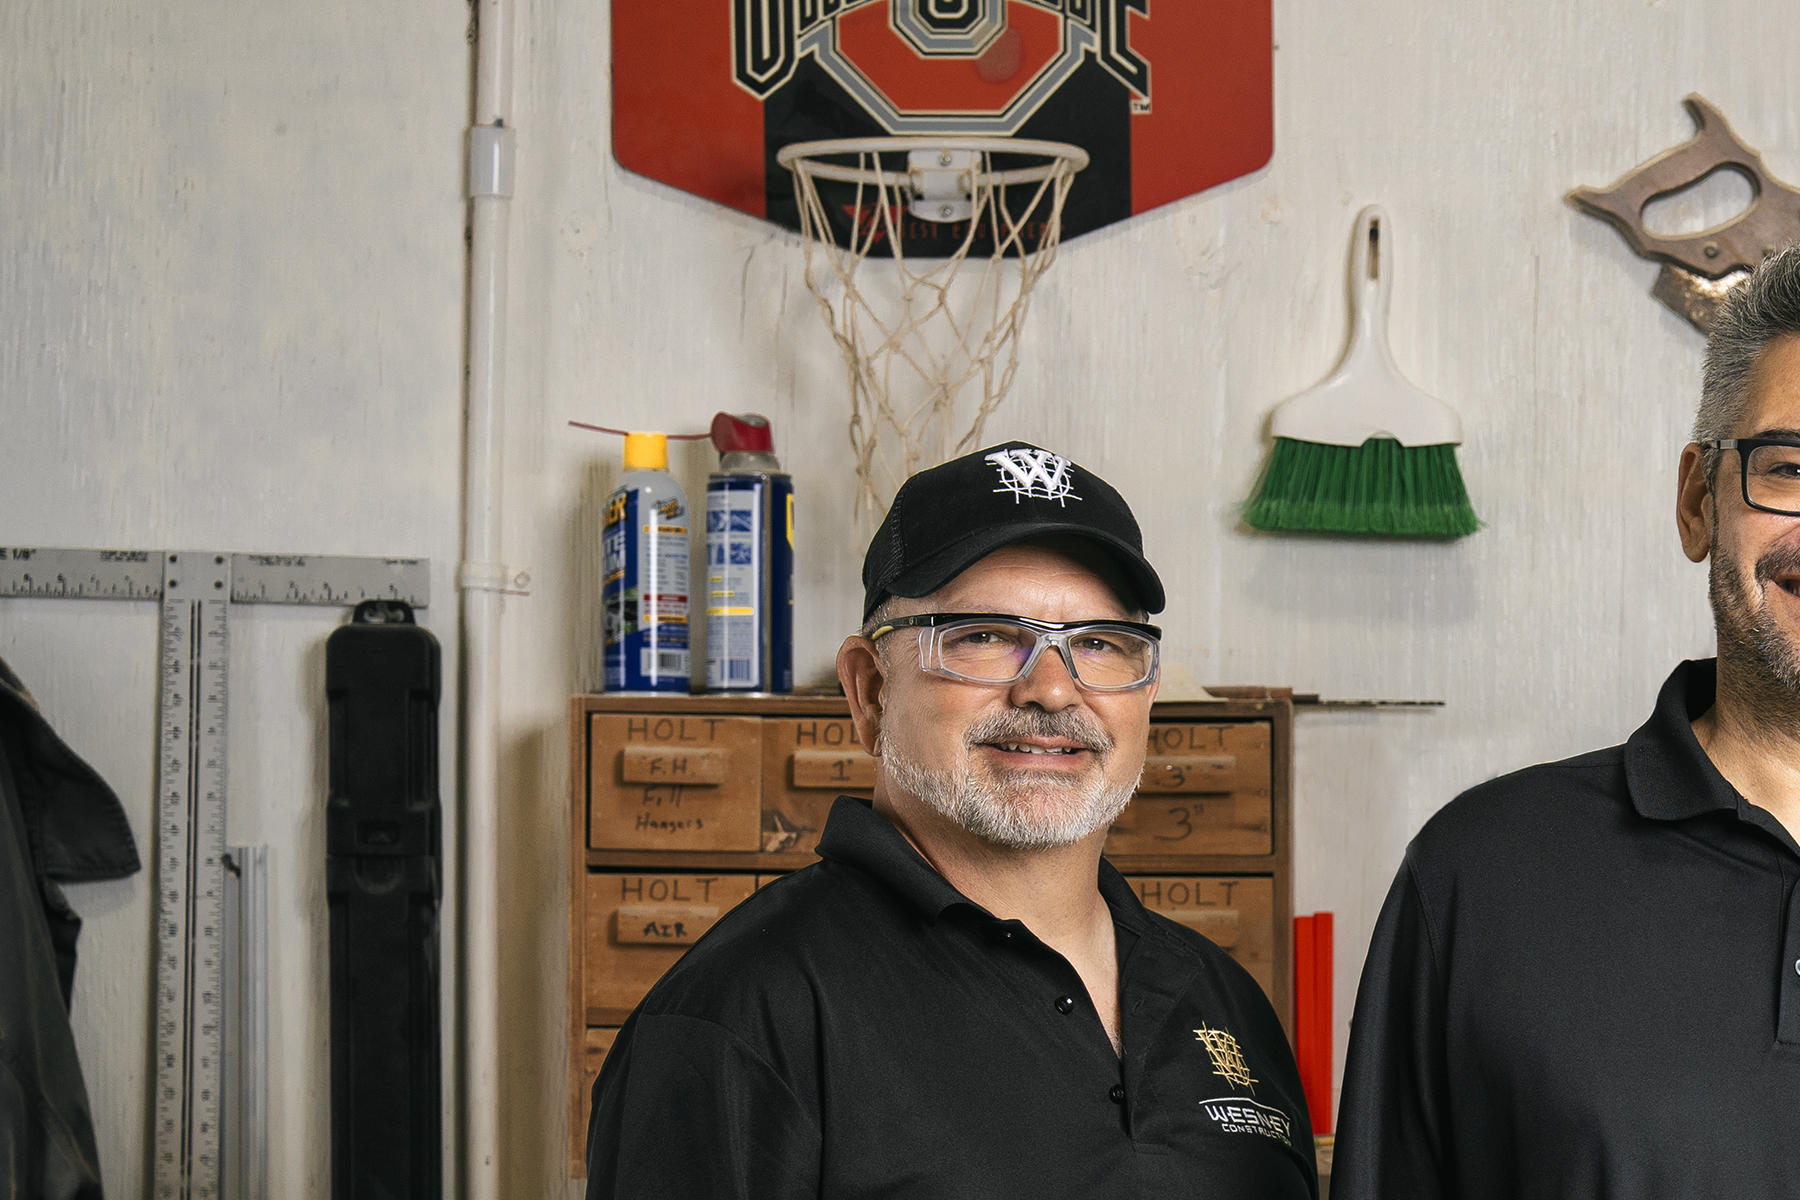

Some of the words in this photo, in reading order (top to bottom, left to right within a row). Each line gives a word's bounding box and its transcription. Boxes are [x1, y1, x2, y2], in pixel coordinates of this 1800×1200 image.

[627, 717, 726, 743] HOLT
[796, 721, 860, 746] HOL
[620, 877, 720, 902] HOLT
[1140, 881, 1240, 907] HOLT
[643, 920, 688, 939] AIR
[1204, 1104, 1291, 1138] WESNEY
